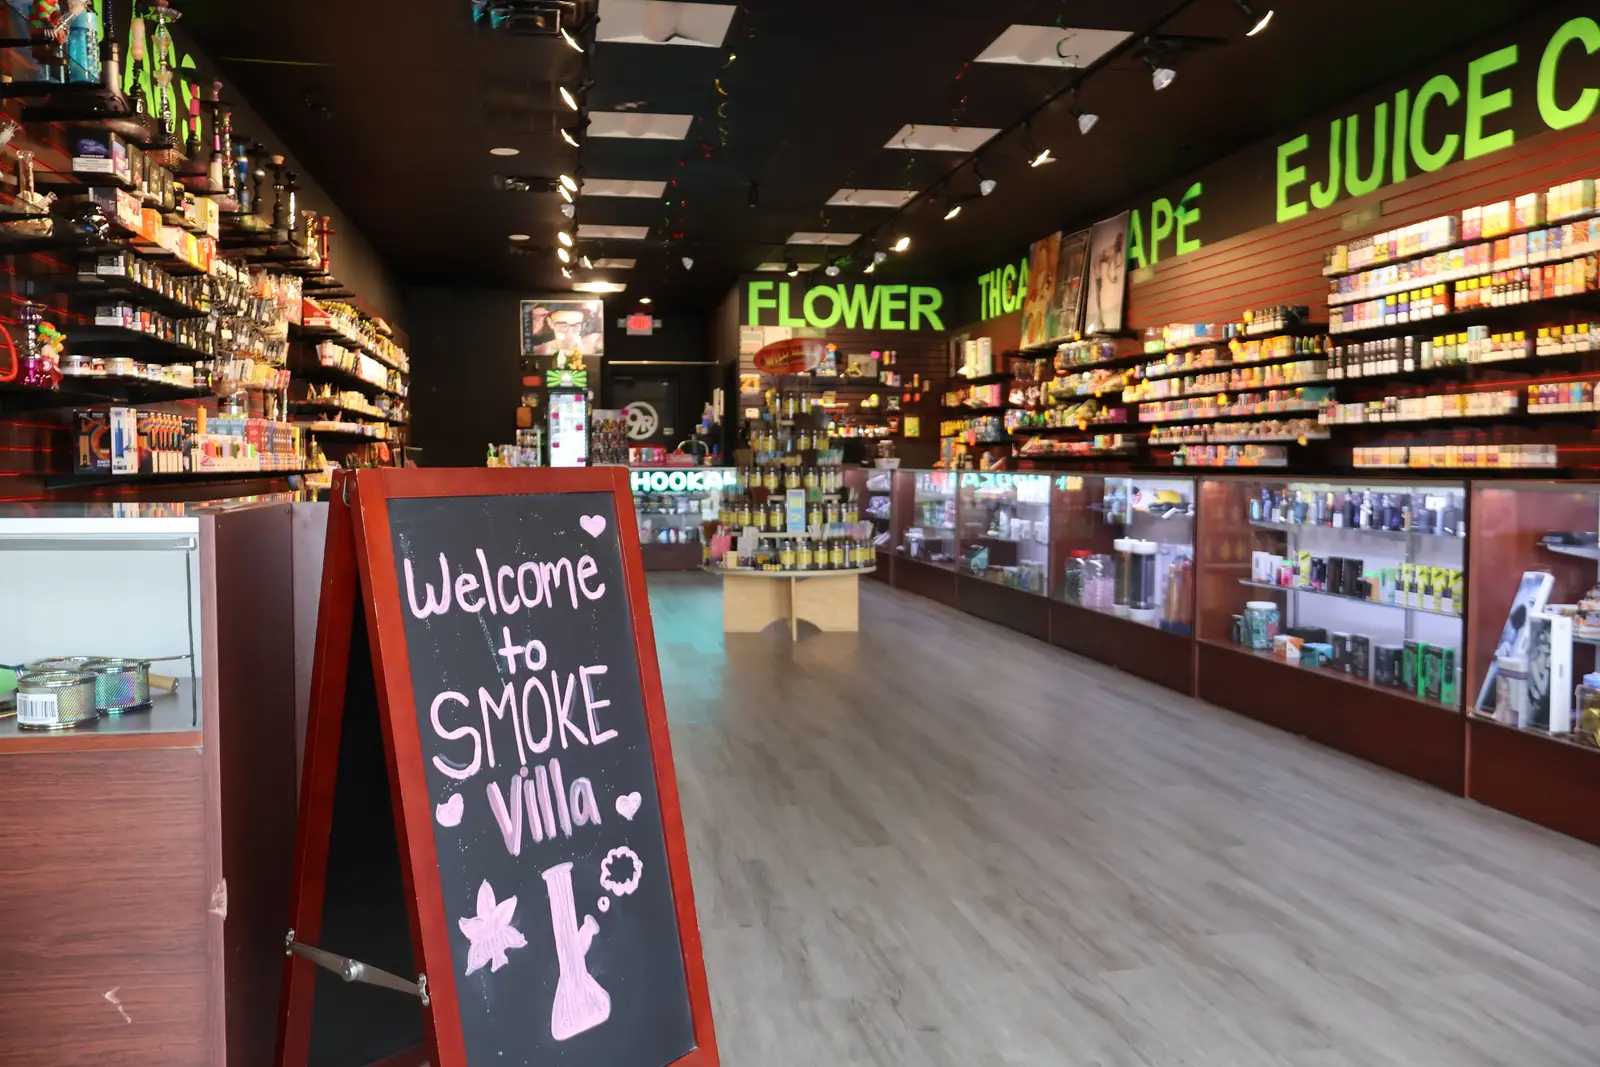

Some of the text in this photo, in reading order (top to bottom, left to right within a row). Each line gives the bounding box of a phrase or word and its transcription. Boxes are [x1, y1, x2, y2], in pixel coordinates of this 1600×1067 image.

[1277, 45, 1518, 223] EJUICE
[1127, 182, 1204, 270] APE
[748, 281, 945, 331] FLOWER
[403, 549, 606, 619] Welcome
[497, 626, 547, 675] to
[430, 665, 619, 780] SMOKE
[486, 757, 602, 857] Villa
